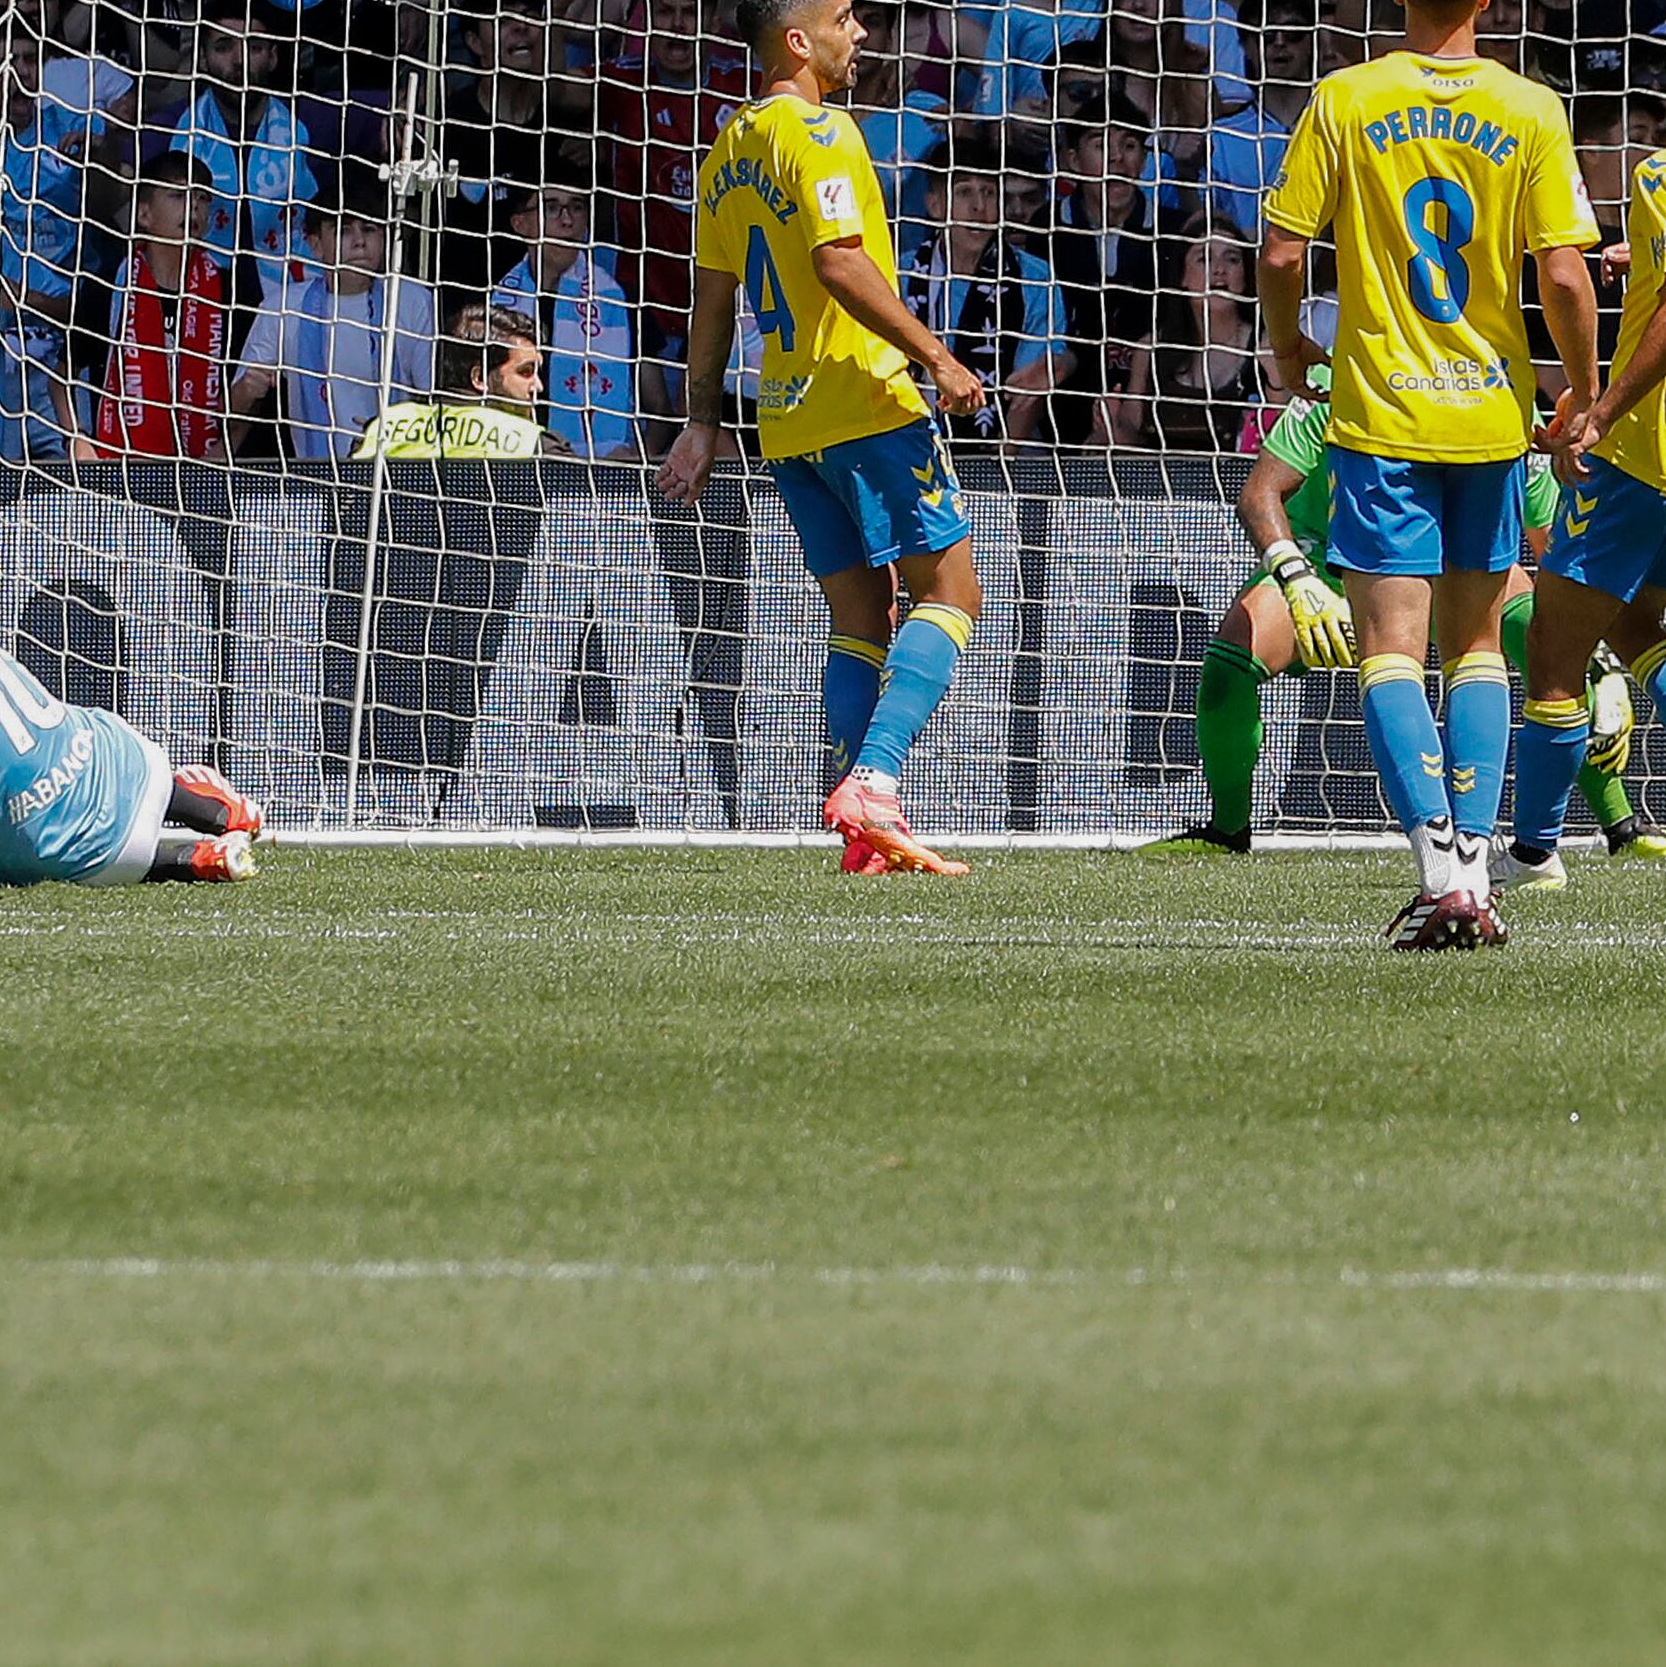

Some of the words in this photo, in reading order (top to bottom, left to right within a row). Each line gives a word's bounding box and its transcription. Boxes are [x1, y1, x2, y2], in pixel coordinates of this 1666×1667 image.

[1362, 104, 1521, 169] PERRONE
[1402, 175, 1476, 324] 8
[745, 224, 796, 353] 4
[1387, 370, 1485, 392] Canarias
[1433, 356, 1480, 375] Islas
